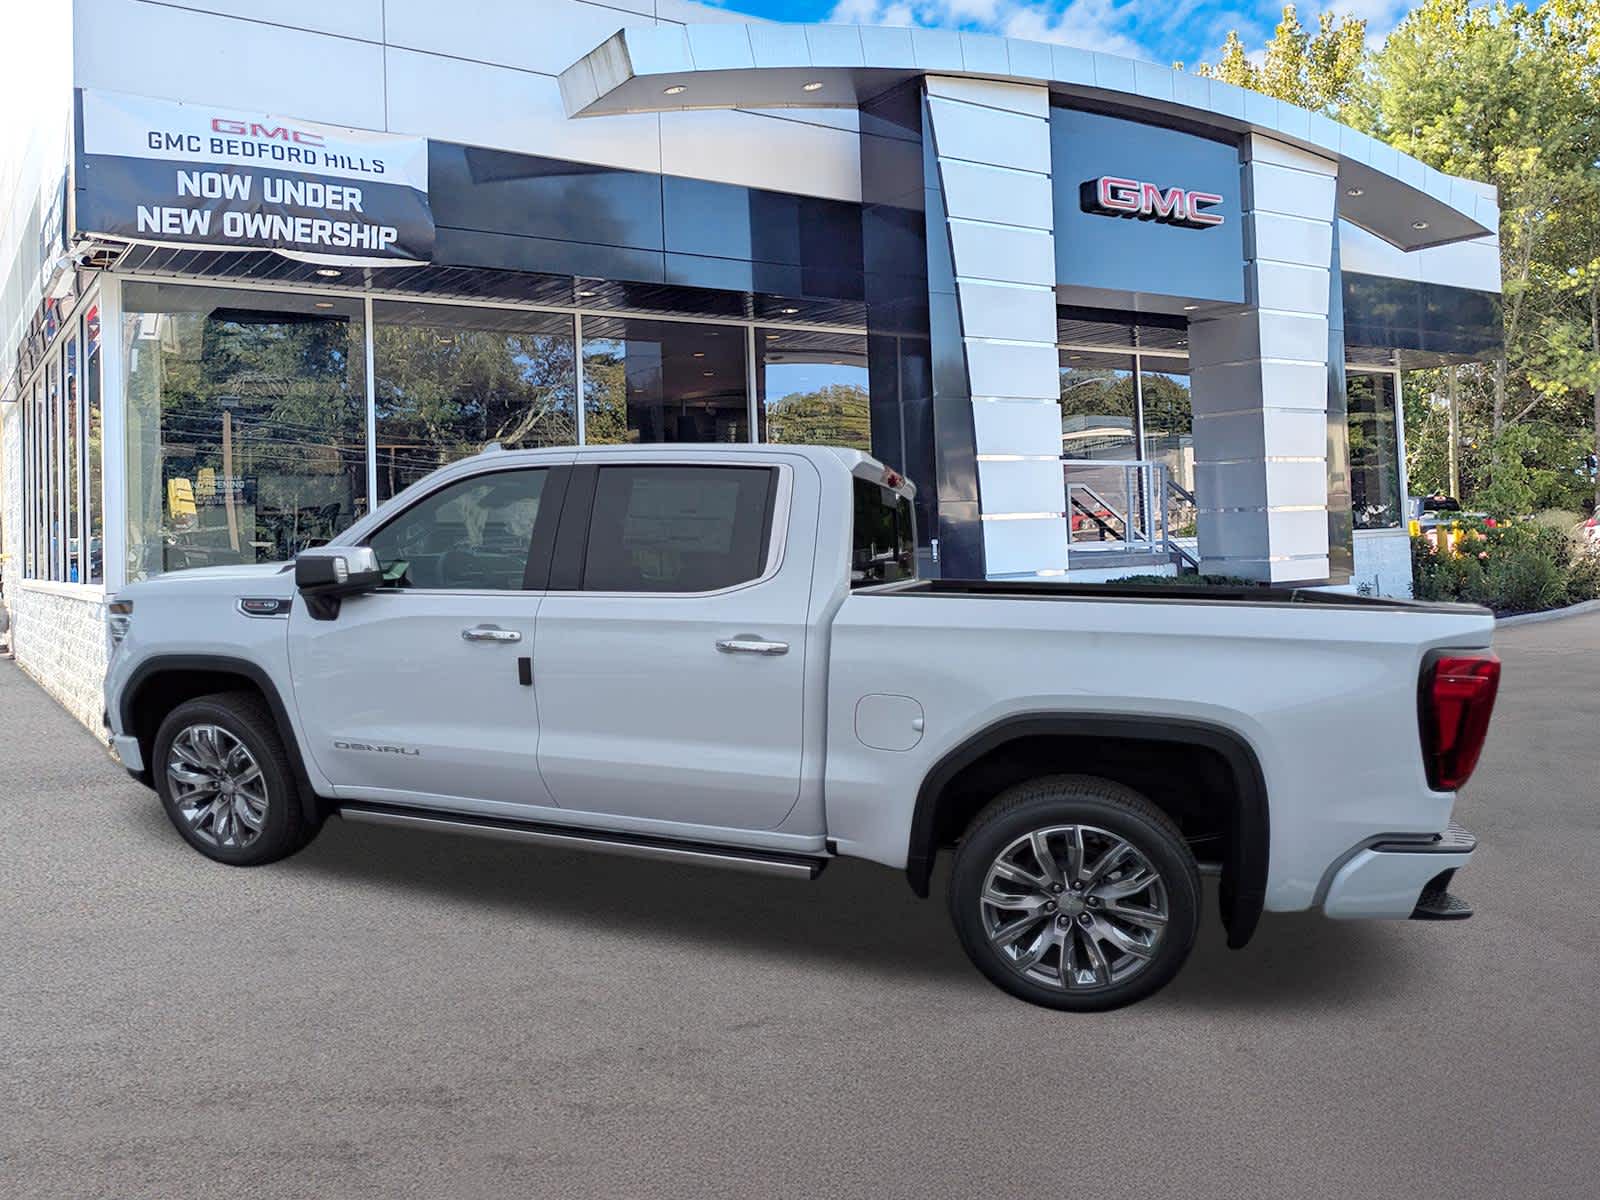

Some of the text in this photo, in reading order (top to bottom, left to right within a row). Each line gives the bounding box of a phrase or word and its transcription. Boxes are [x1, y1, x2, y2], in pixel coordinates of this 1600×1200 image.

[148, 131, 385, 174] GMC BEDFORD HILLS
[211, 118, 326, 148] GMC
[177, 170, 364, 213] NOW UNDER
[1097, 175, 1225, 225] GMC
[136, 205, 398, 250] NEW OWNERSHIP
[334, 741, 420, 756] DENALI
